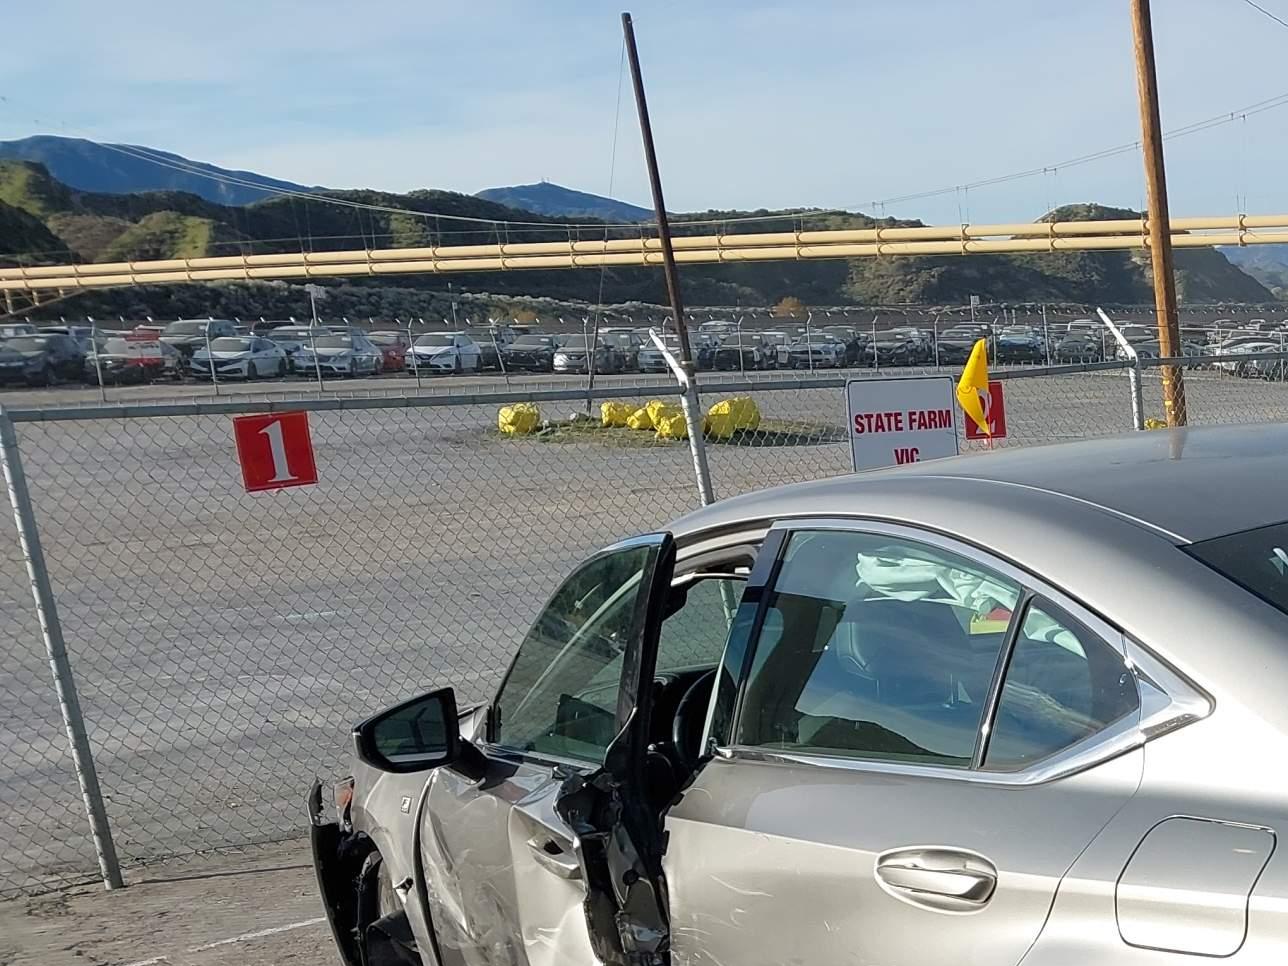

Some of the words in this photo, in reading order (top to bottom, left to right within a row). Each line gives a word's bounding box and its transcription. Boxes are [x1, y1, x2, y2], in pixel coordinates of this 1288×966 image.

[854, 412, 903, 434] STATE
[908, 409, 952, 430] FARM
[258, 419, 299, 483] 1
[894, 447, 921, 465] VIC
